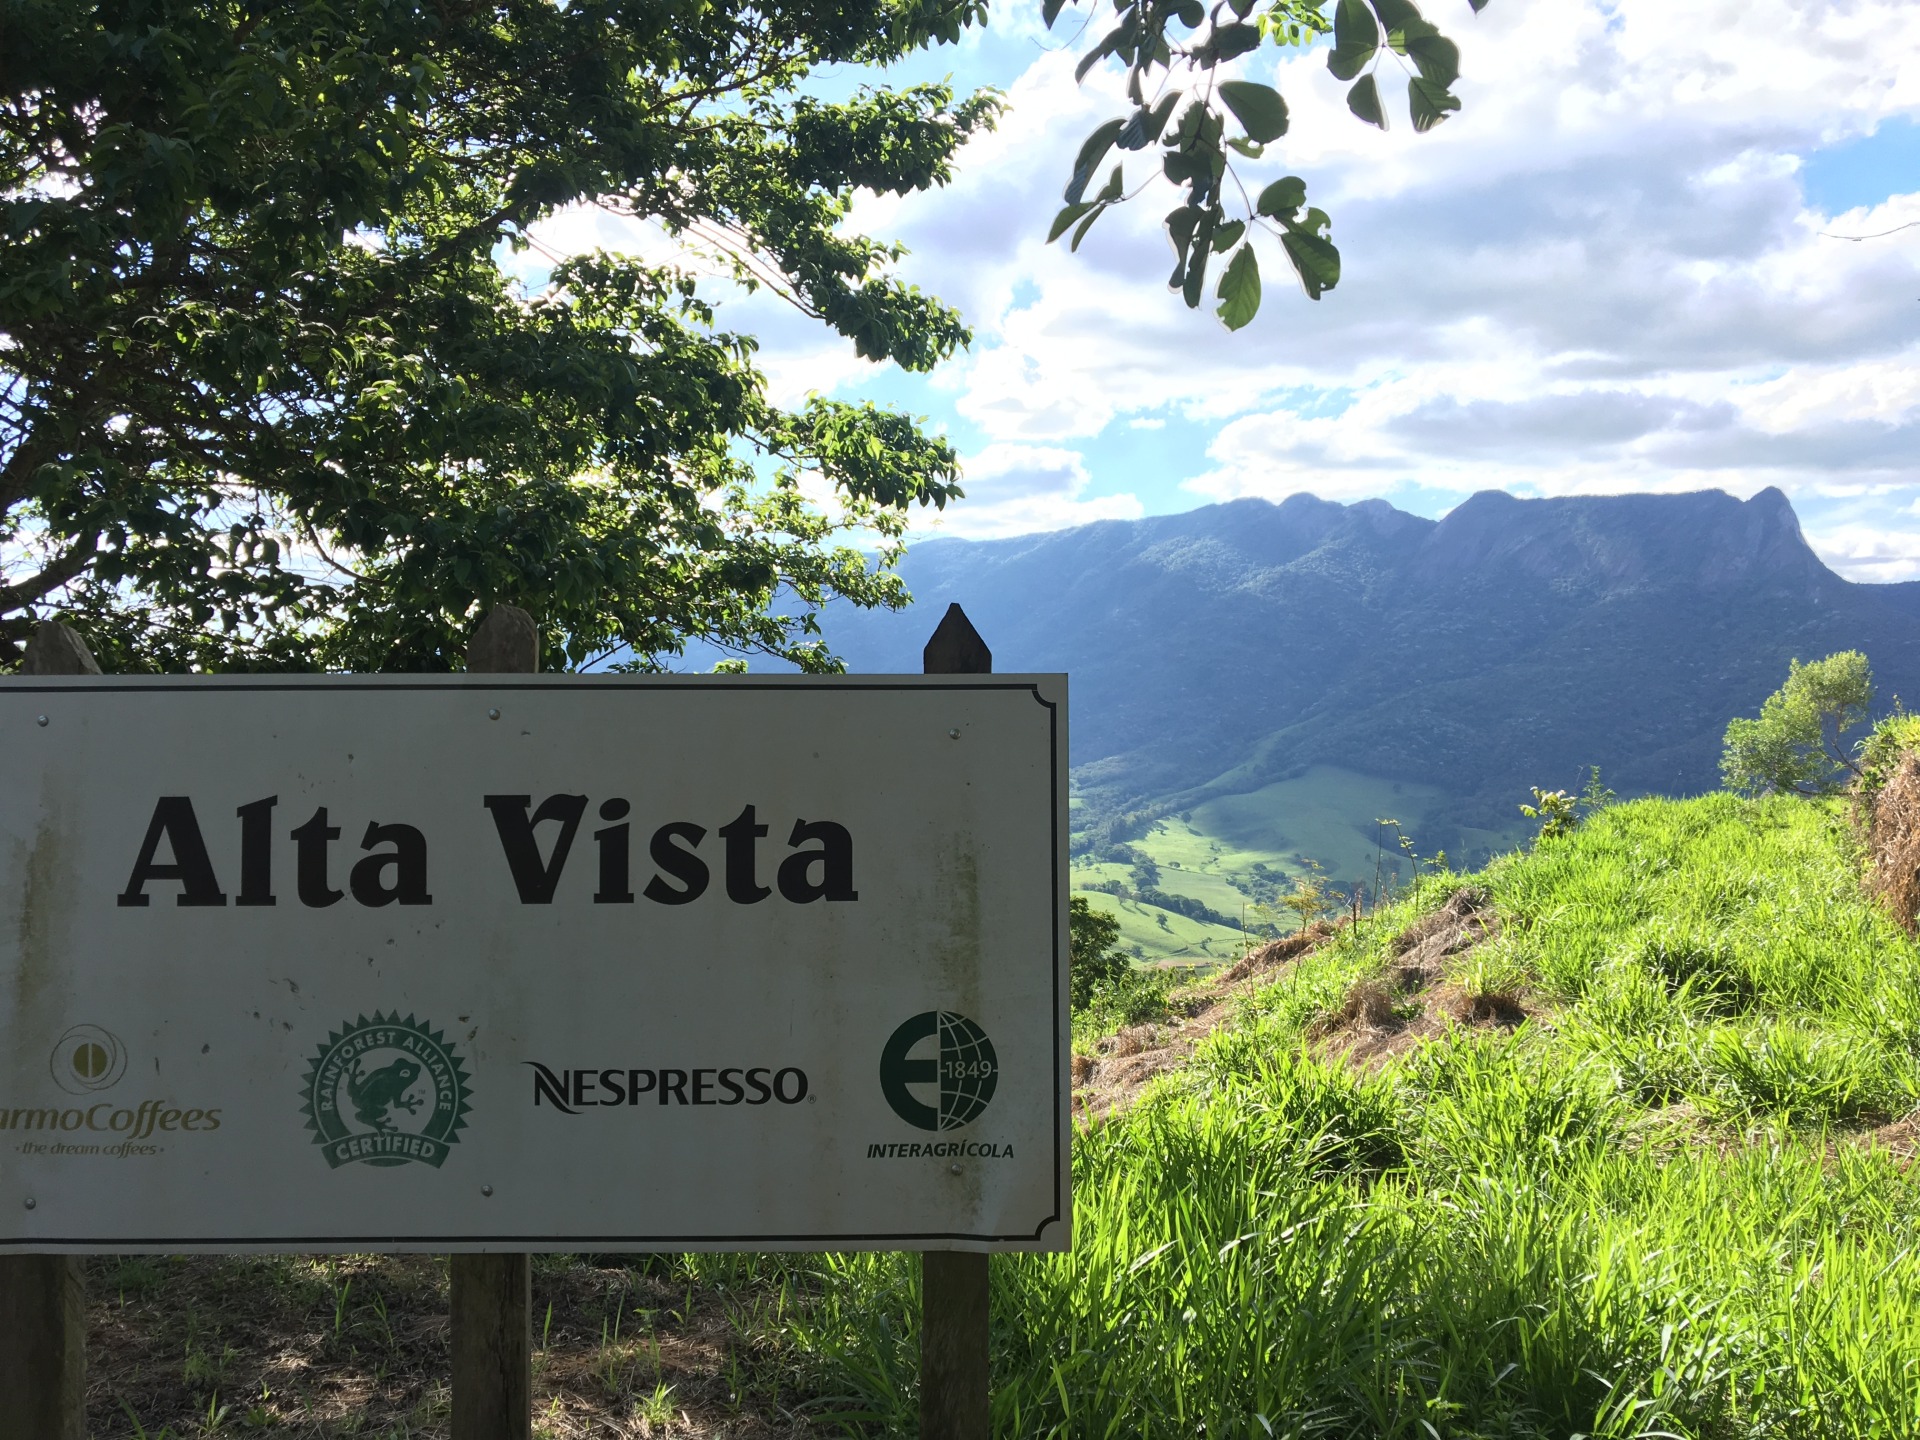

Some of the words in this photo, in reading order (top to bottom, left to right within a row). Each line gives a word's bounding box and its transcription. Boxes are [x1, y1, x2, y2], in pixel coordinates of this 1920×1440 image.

[117, 795, 433, 908] Alta
[483, 793, 859, 906] Vista
[321, 1031, 396, 1111] RAINFOREST
[402, 1036, 452, 1111] ALLIANCE
[945, 1060, 992, 1079] 1849
[50, 1142, 100, 1156] dream
[335, 1136, 435, 1159] CERTIFIED
[866, 1139, 1015, 1159] INTERAGRÍCOLA
